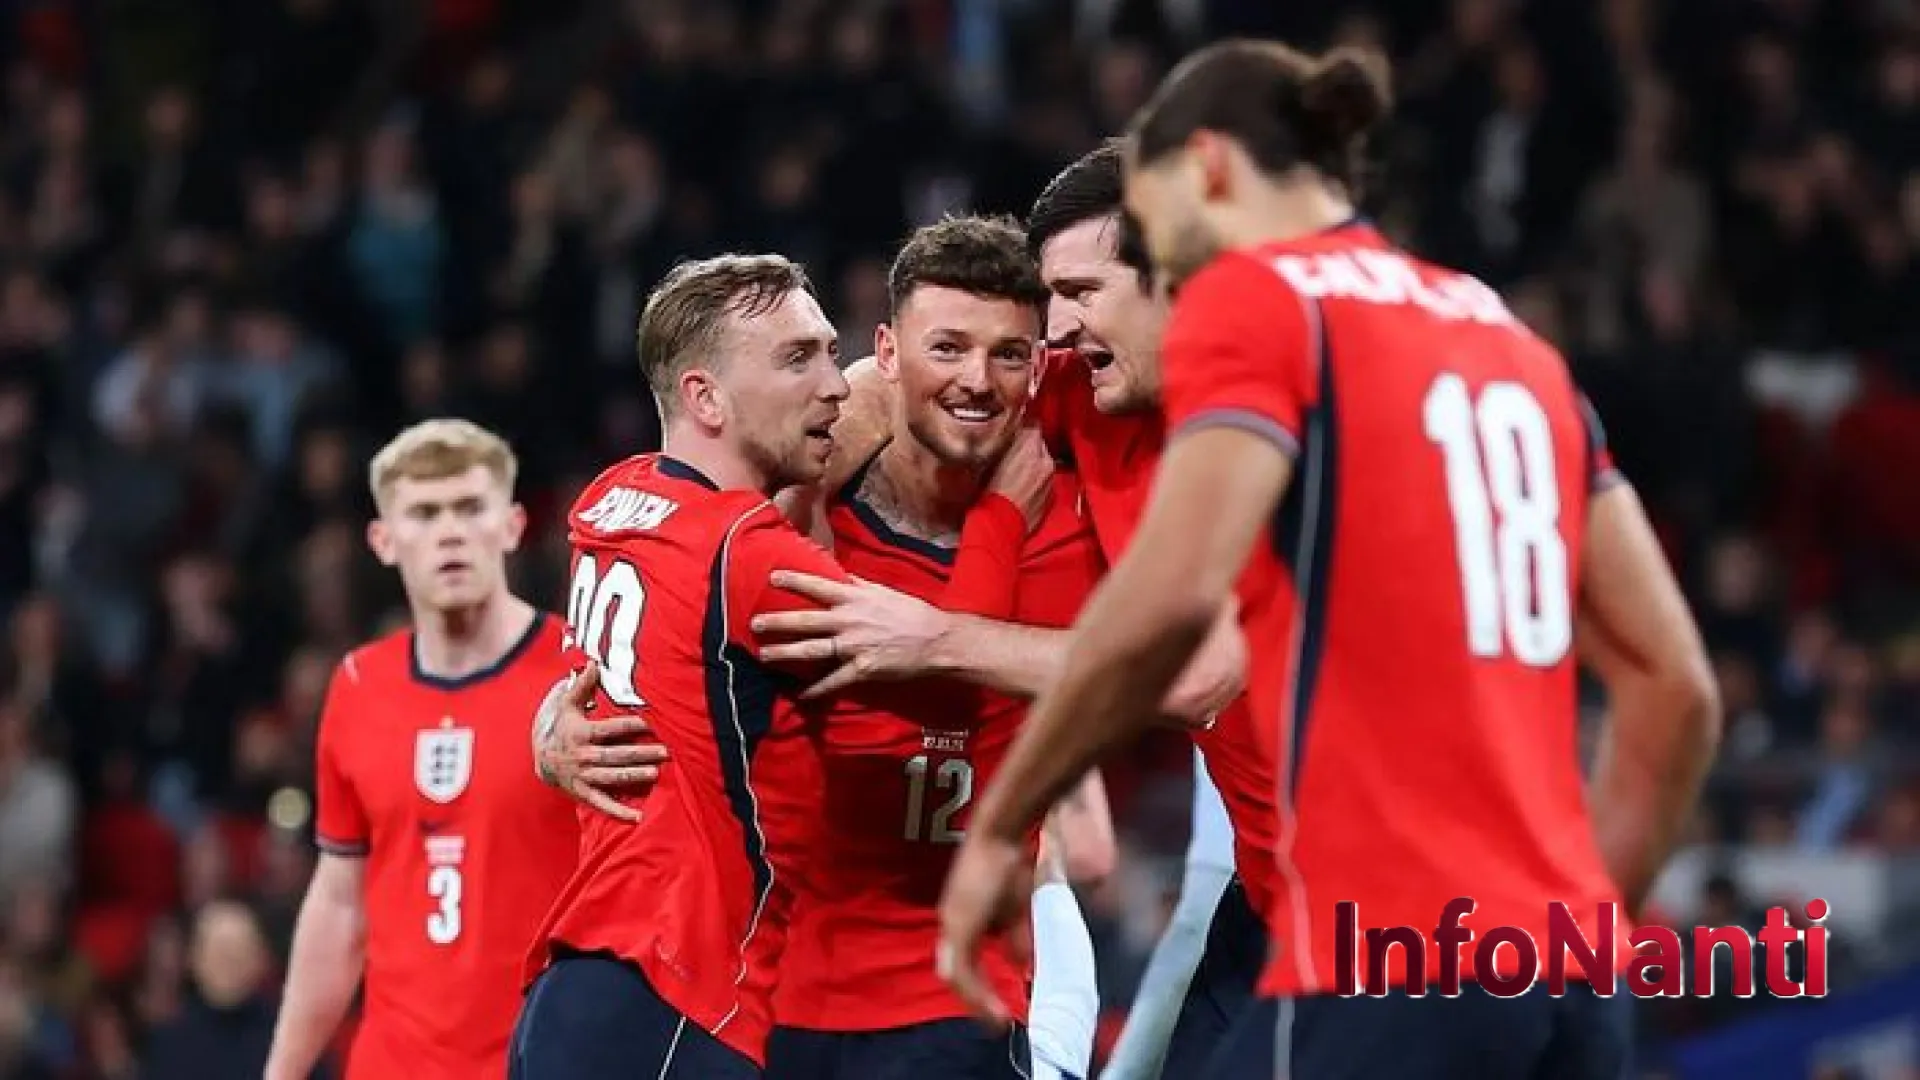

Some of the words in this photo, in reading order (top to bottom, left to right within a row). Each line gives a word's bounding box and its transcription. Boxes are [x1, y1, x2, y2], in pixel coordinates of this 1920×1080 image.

[1422, 371, 1571, 666] 18
[904, 756, 974, 842] 12
[427, 867, 462, 943] 3
